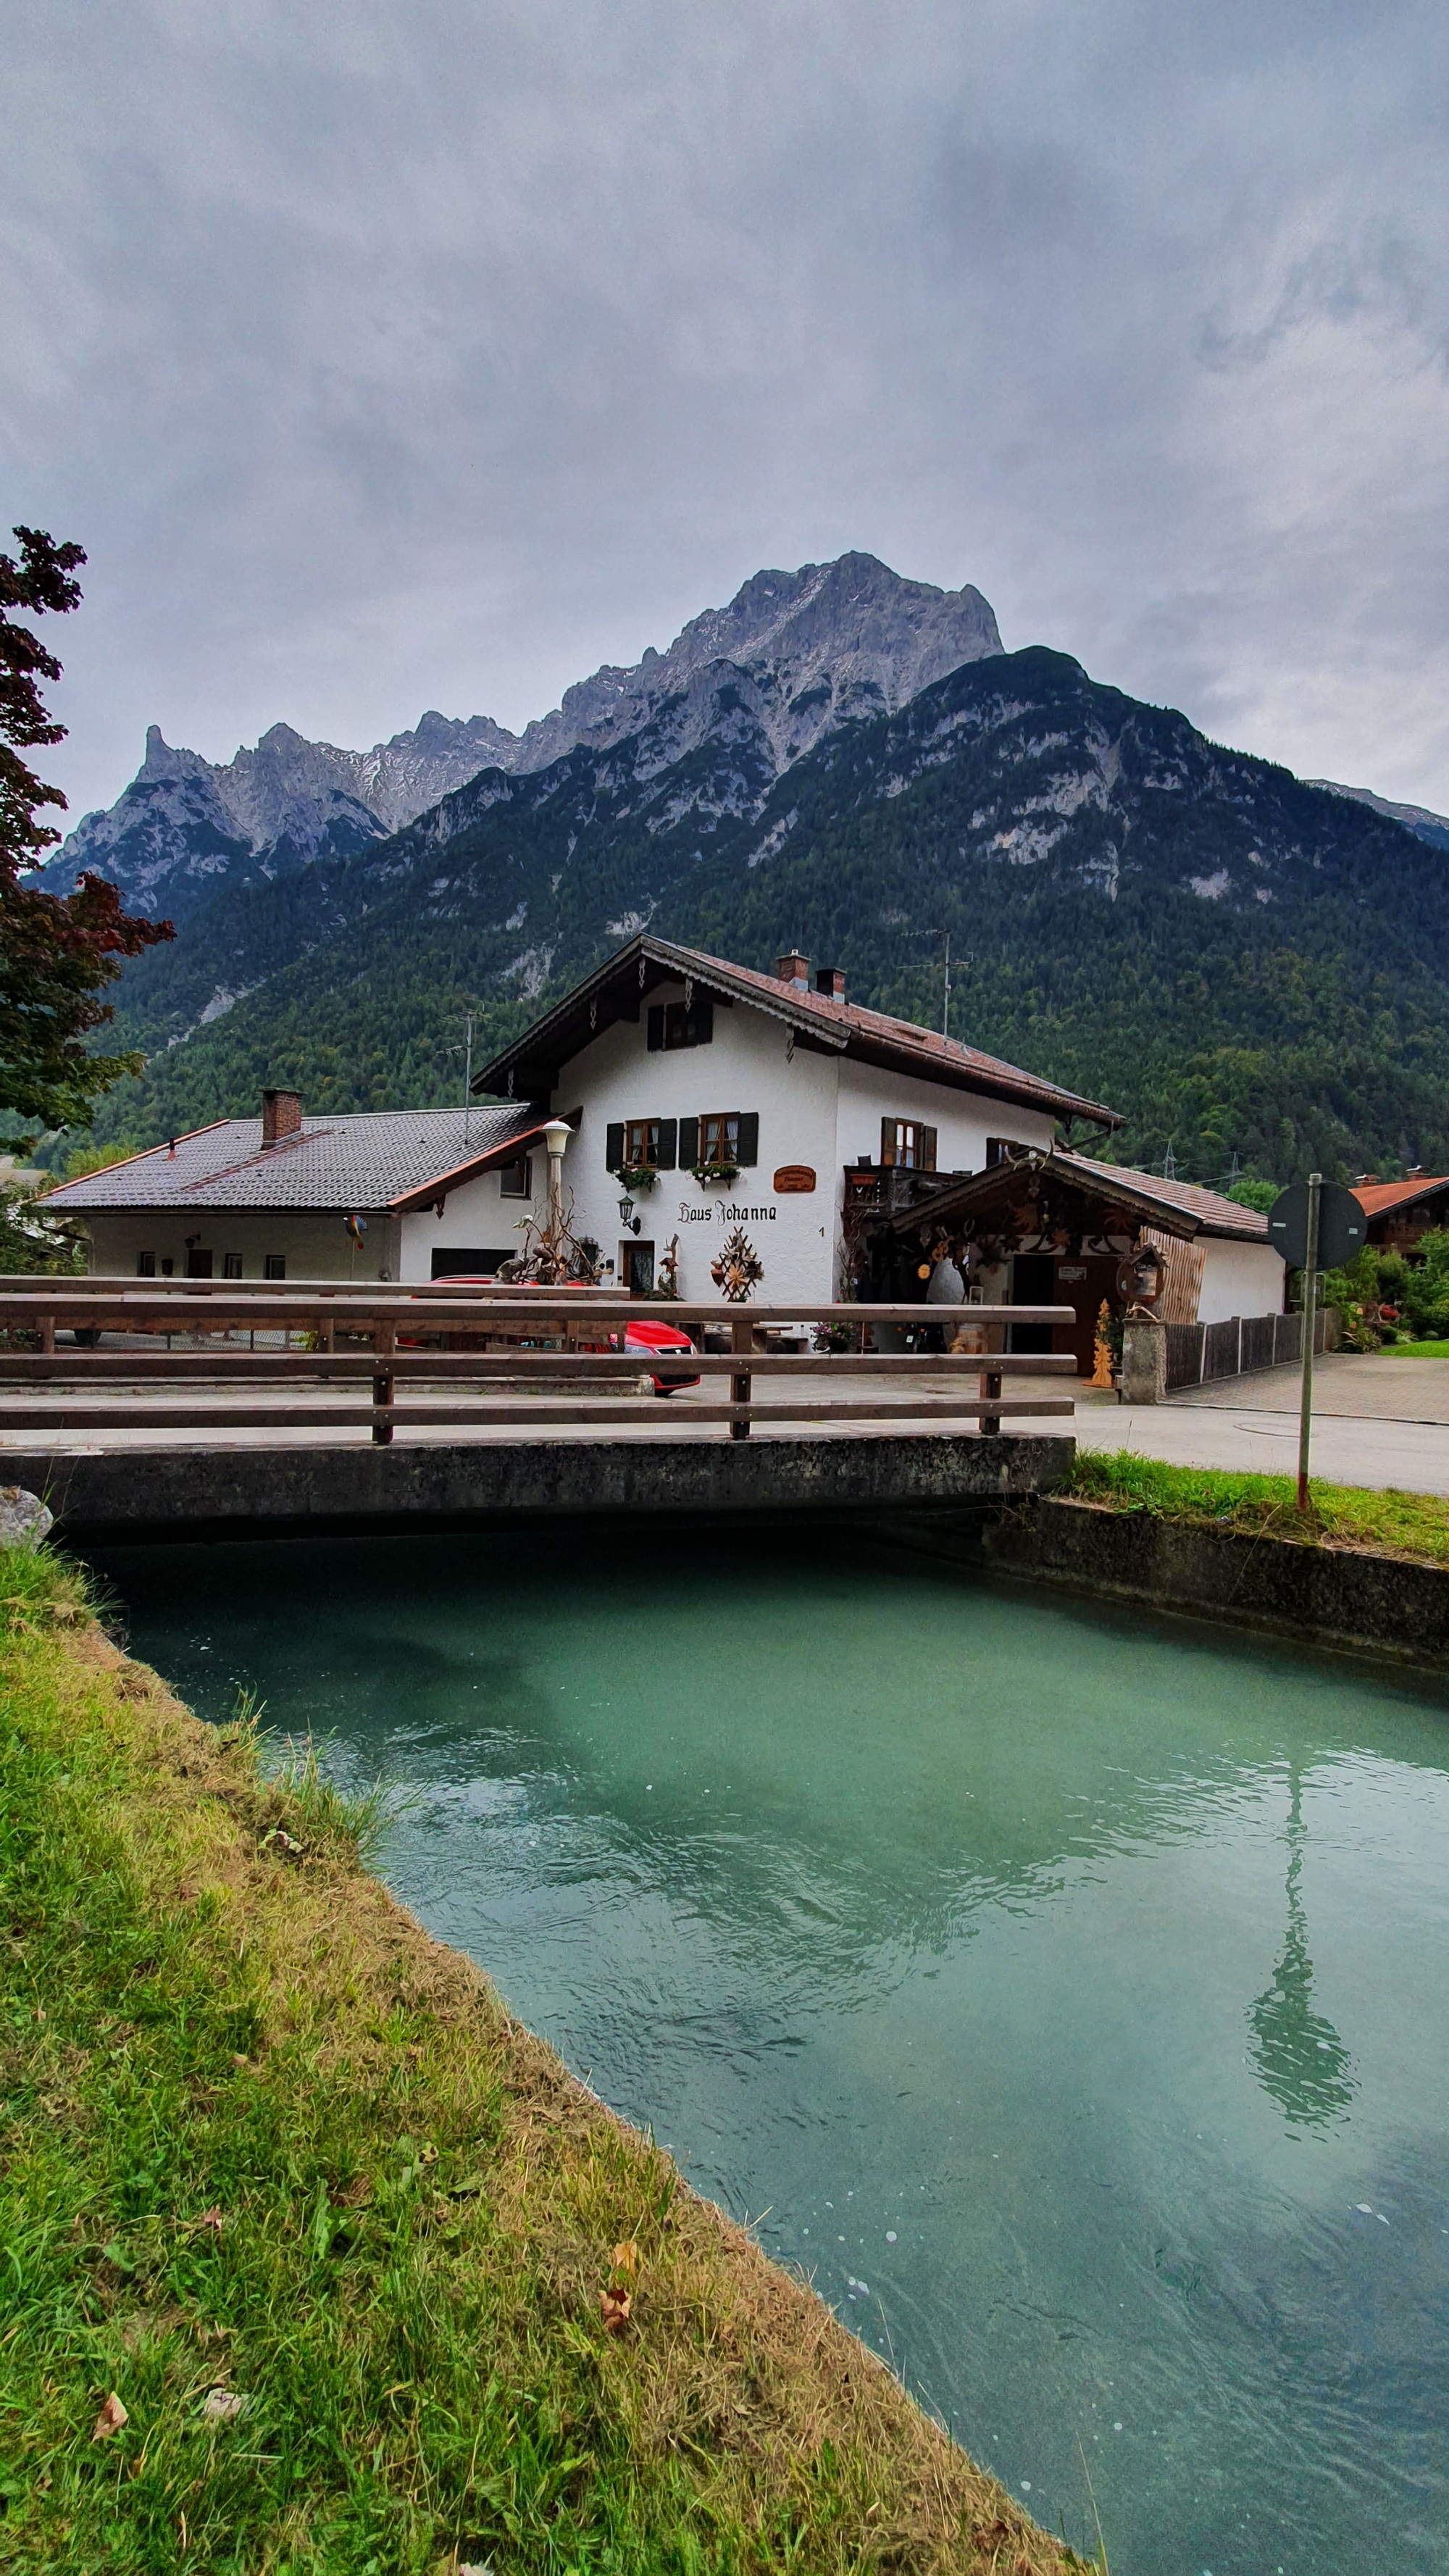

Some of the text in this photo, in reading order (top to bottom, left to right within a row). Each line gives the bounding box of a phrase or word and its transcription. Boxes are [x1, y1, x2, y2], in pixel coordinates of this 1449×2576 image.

[677, 1200, 776, 1226] Haus Johanna
[819, 1227, 824, 1237] 1
